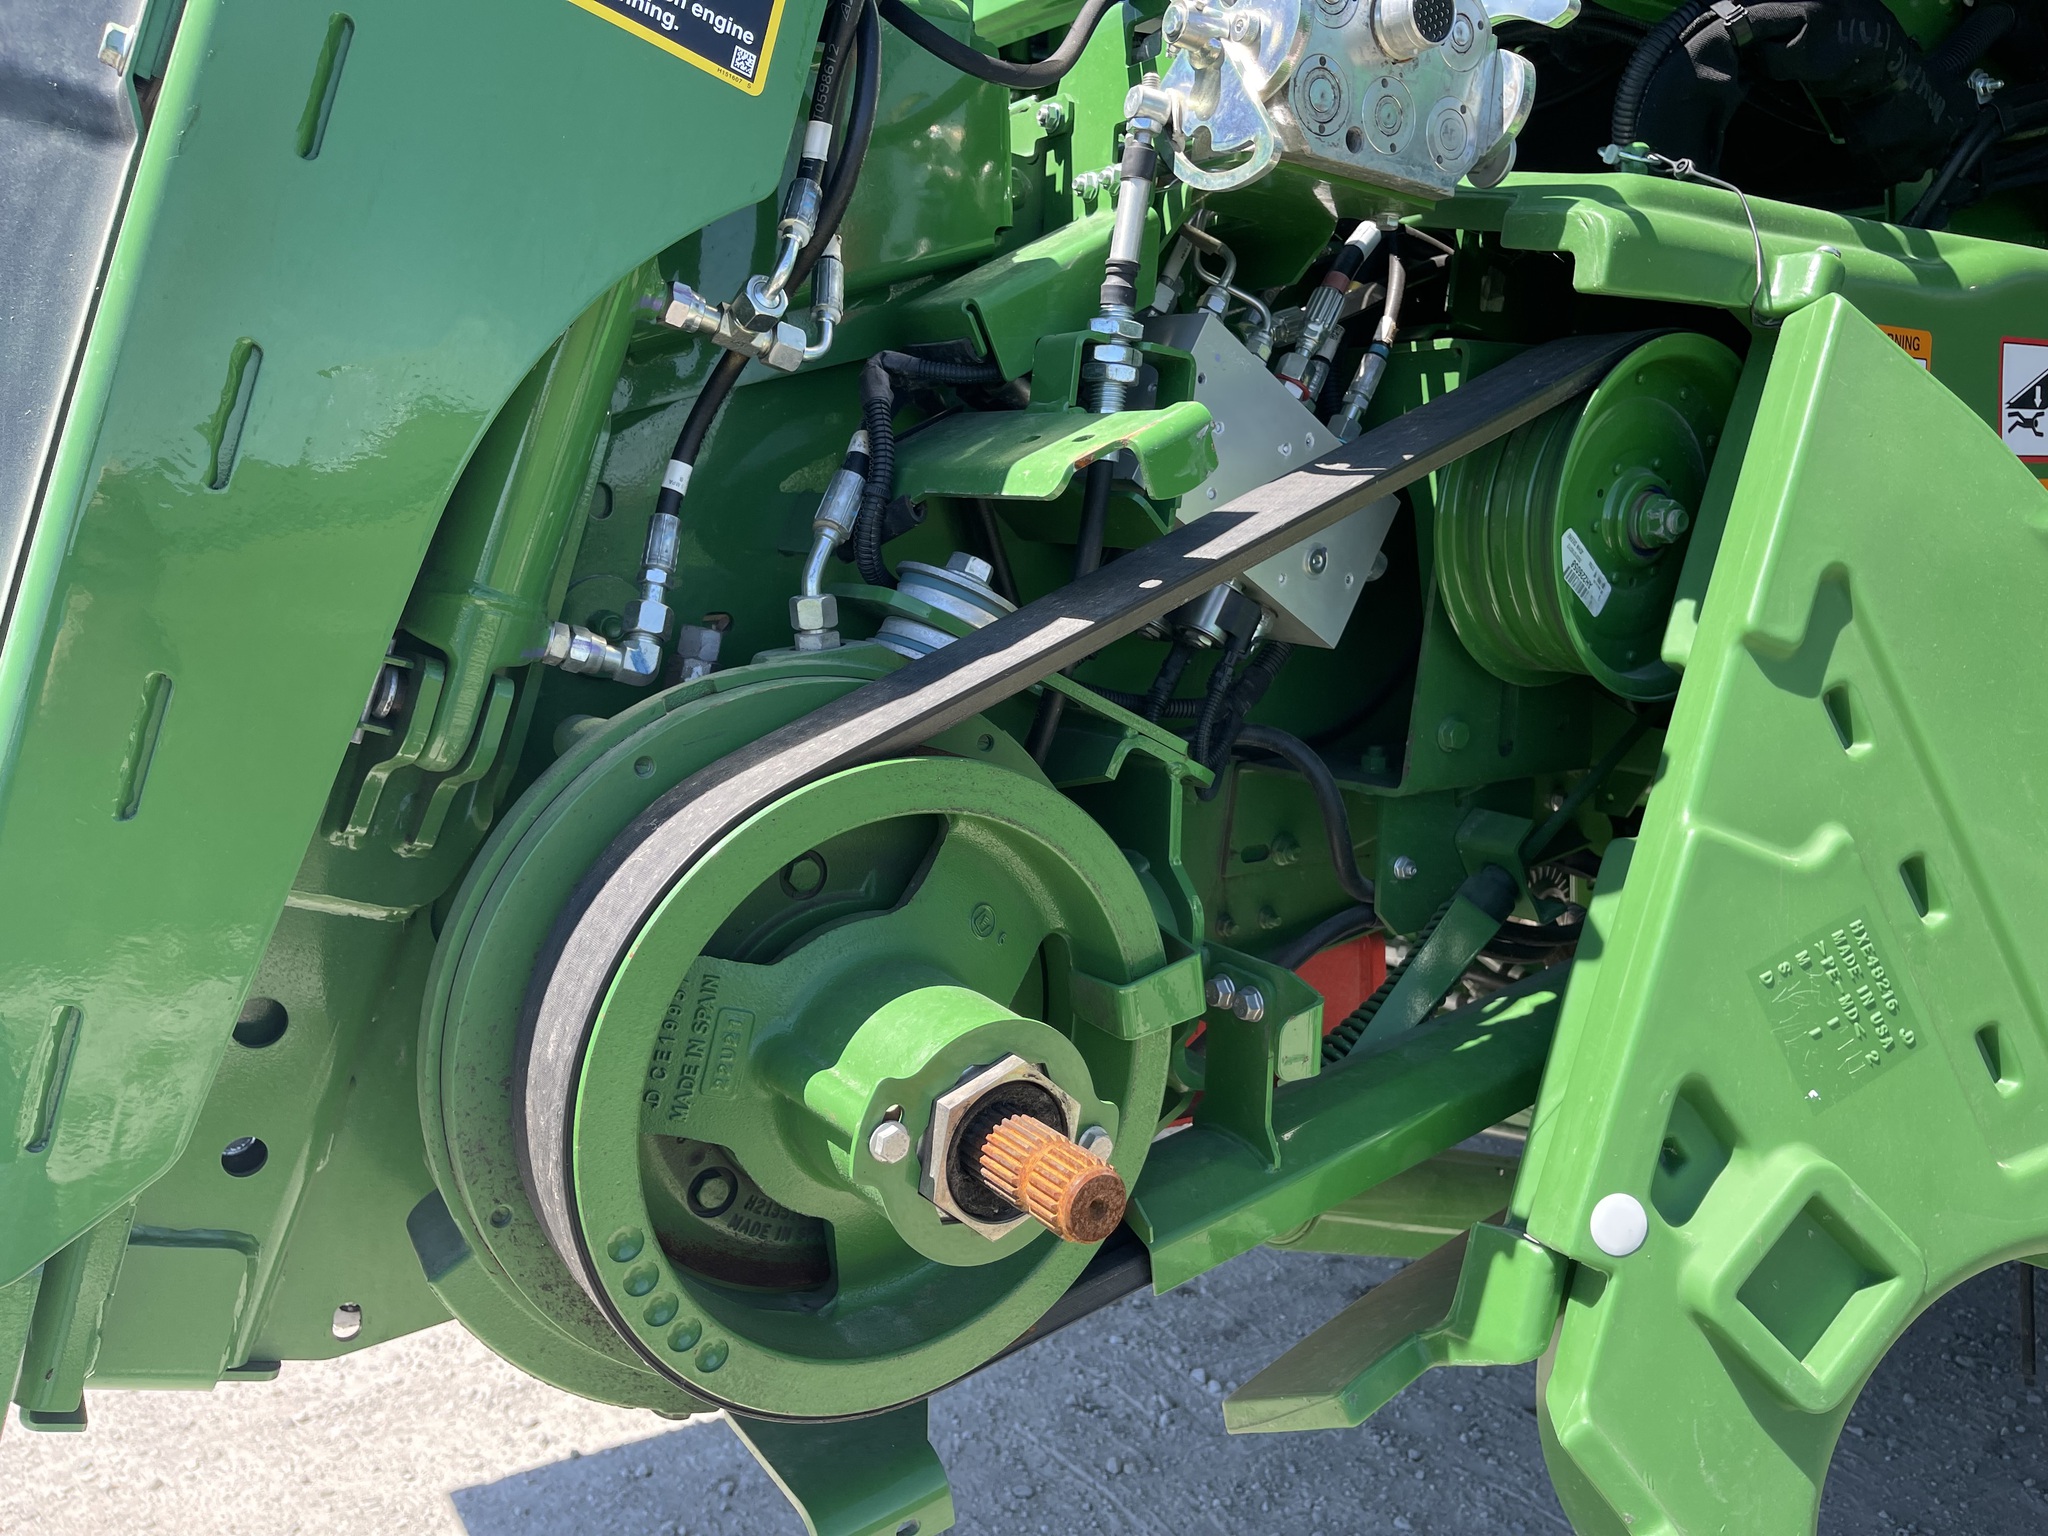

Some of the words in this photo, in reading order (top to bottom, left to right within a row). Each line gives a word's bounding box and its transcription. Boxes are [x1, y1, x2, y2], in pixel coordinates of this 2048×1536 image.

[619, 0, 679, 31] ning.
[691, 2, 755, 45] engine
[1831, 929, 1862, 979] MADE
[1856, 985, 1875, 1006] IN
[1870, 1011, 1894, 1049] USA
[1849, 919, 1899, 1012] HXE48216
[691, 973, 720, 1035] SPAIN
[685, 1037, 706, 1058] IN
[668, 1064, 700, 1123] MADE
[727, 1213, 771, 1240] MADE
[774, 1225, 792, 1242] IN
